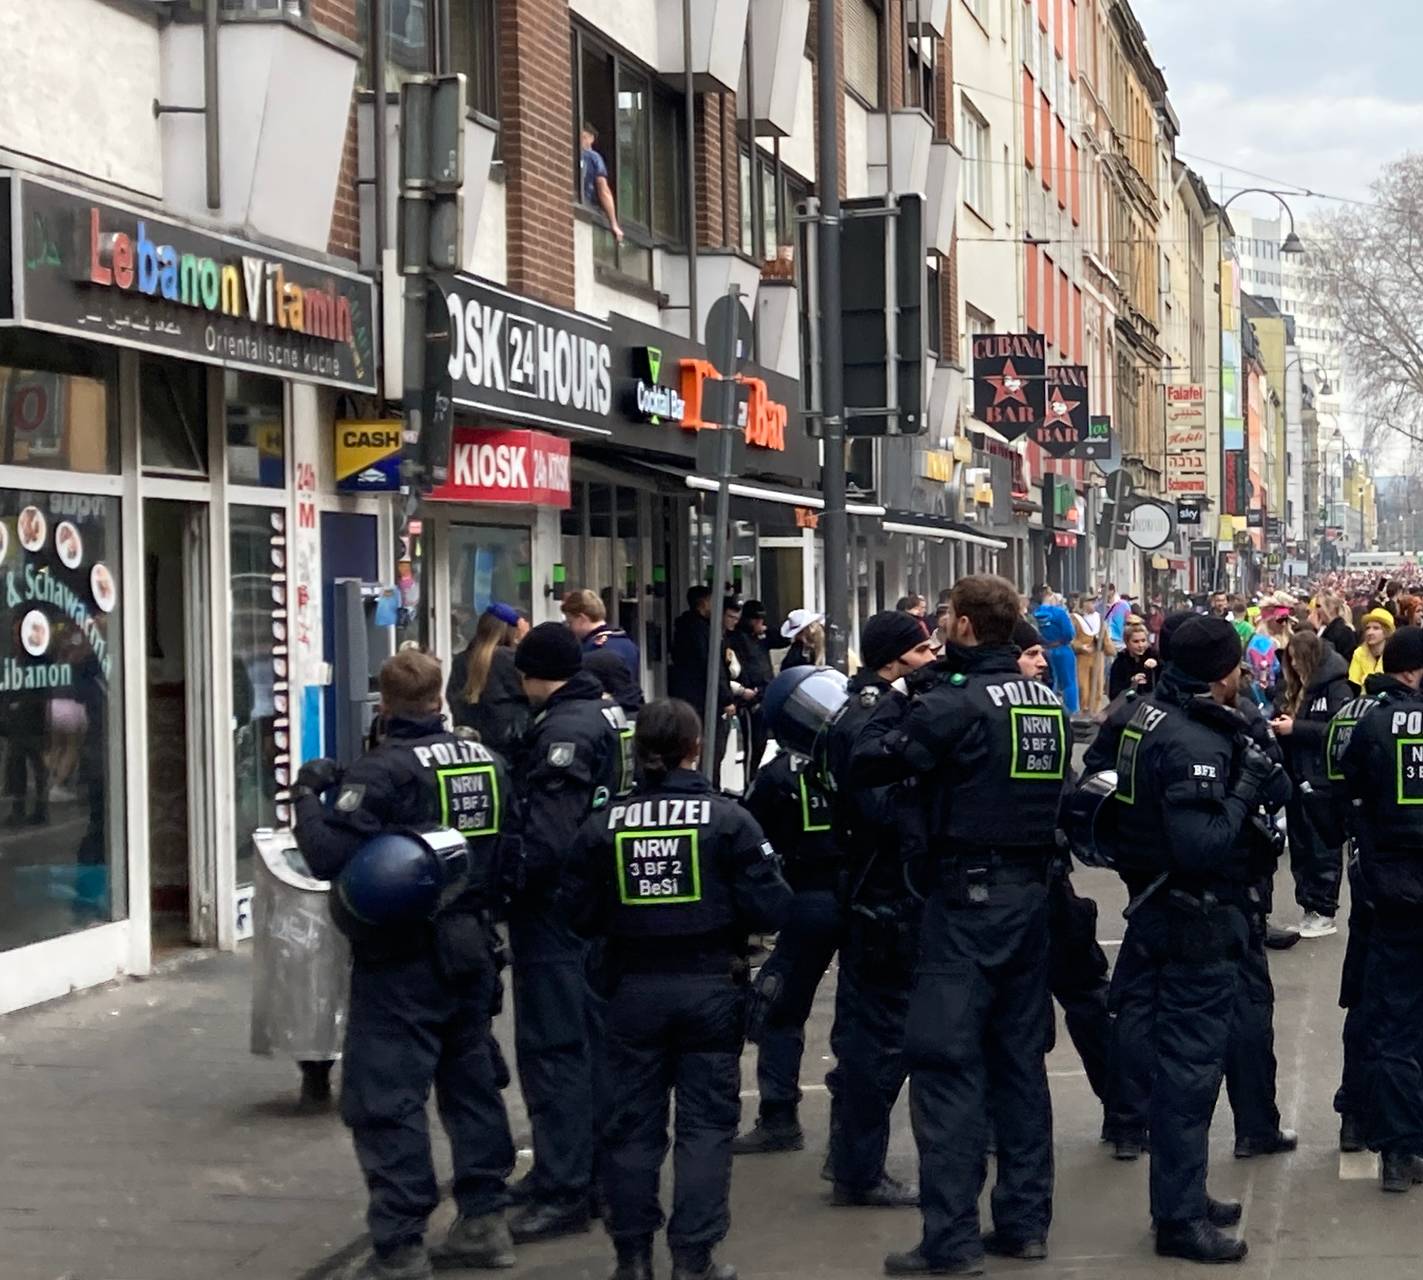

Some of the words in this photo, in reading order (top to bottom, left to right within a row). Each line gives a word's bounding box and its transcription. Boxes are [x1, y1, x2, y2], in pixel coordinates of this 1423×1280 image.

[91, 207, 239, 317] Lebanon
[447, 293, 506, 391] OSK
[510, 327, 534, 384] 24
[537, 324, 612, 416] HOURS
[974, 336, 1044, 360] CUBANA
[1047, 367, 1087, 388] BANA
[1168, 386, 1203, 400] Falafel
[986, 406, 1034, 423] BAR
[343, 431, 400, 448] CASH
[1036, 427, 1079, 442] BAR
[454, 443, 529, 489] KIOSK
[1179, 508, 1198, 521] sky
[6, 571, 24, 609] &
[986, 681, 1064, 707] POLIZE
[1022, 716, 1053, 734] NRW
[413, 740, 494, 767] POLIZE
[1022, 738, 1030, 751] 3
[1032, 738, 1048, 751] BF
[1049, 739, 1057, 751] 2
[1193, 764, 1217, 778] BFE
[1406, 766, 1415, 779] 3
[451, 775, 483, 793] NRW
[452, 798, 460, 811] 3
[462, 796, 478, 810] BF
[481, 796, 488, 807] 2
[608, 800, 711, 829] POLIZEI
[633, 838, 680, 858] NRW
[630, 863, 640, 876] 3
[644, 862, 667, 876] BF
[671, 862, 682, 875] 2
[639, 880, 678, 896] BeSi
